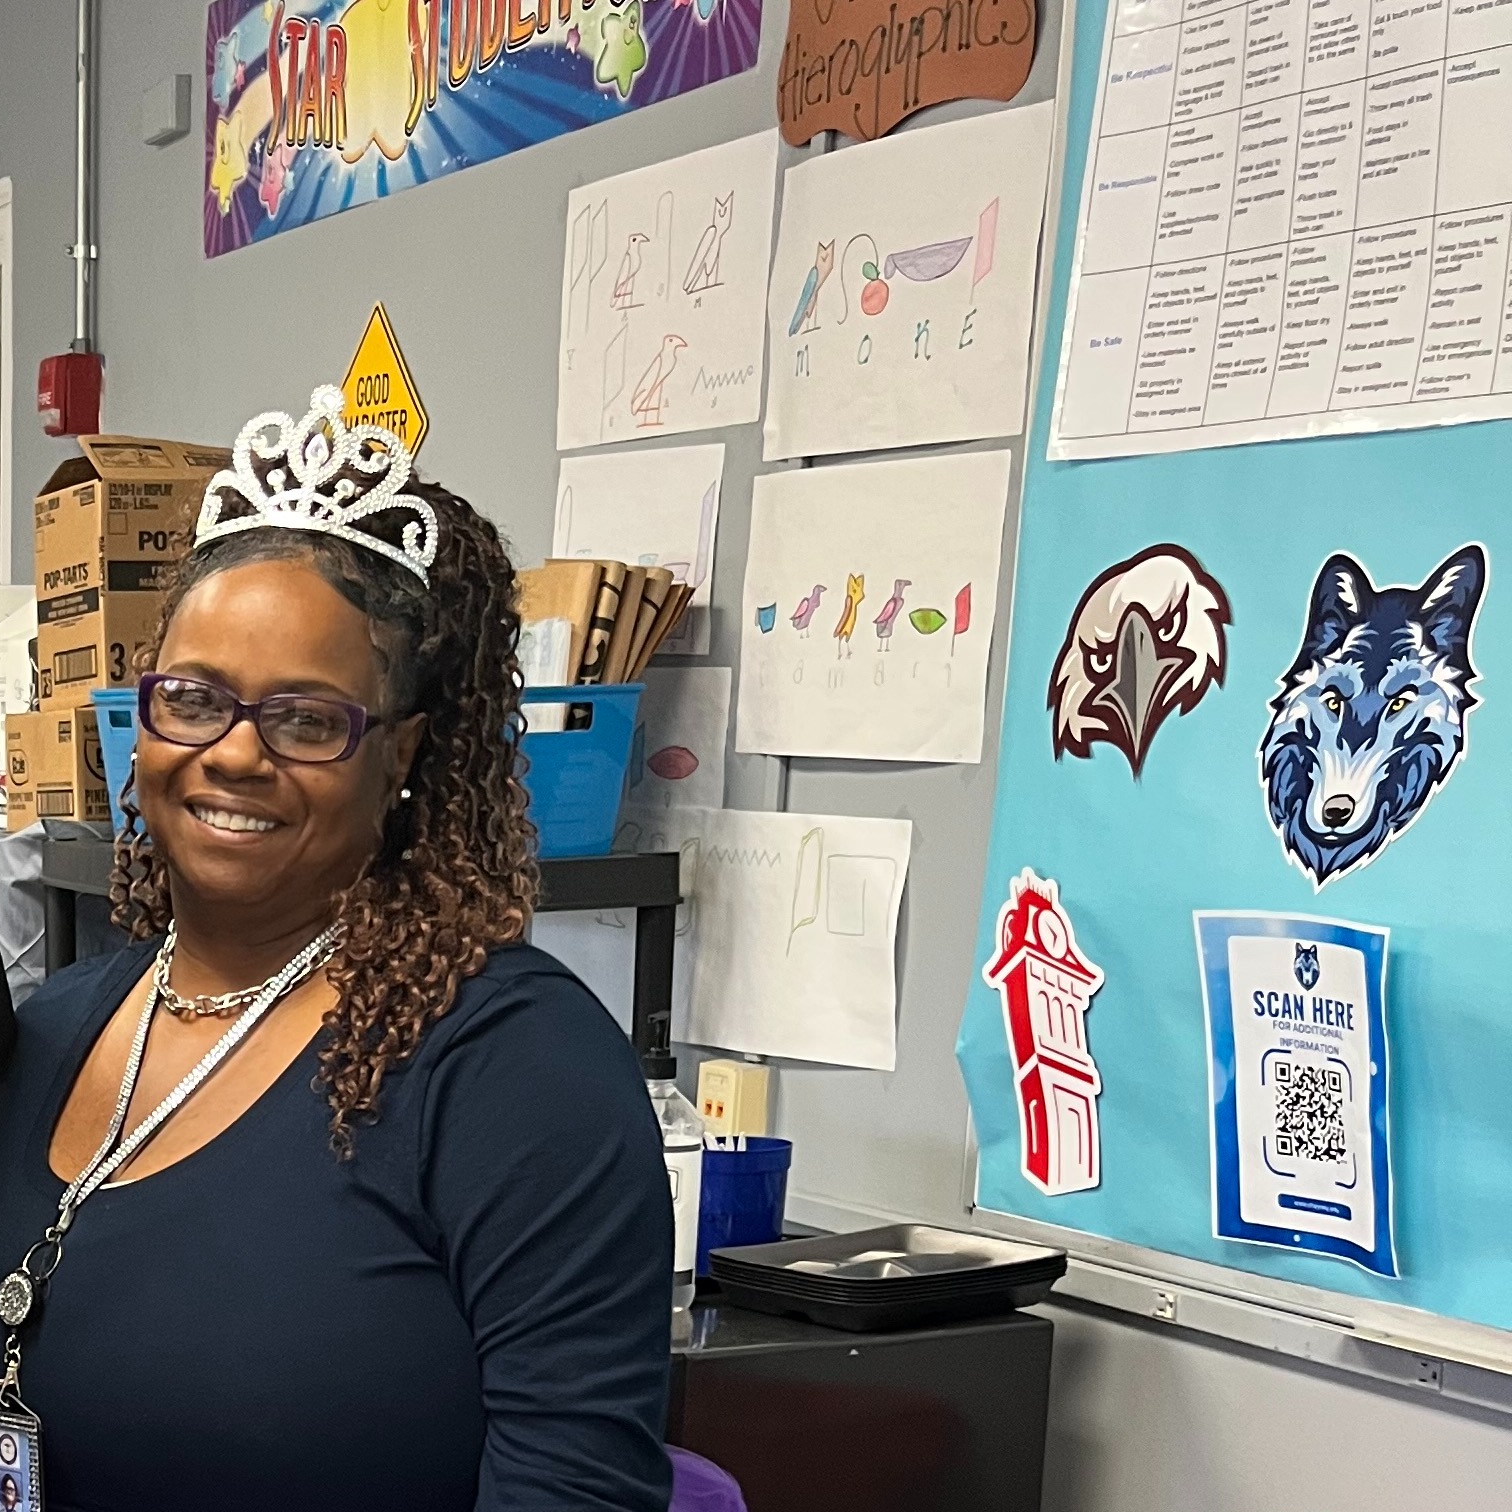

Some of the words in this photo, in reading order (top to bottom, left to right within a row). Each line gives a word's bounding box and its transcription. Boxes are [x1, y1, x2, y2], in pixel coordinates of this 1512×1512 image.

[267, 0, 348, 155] STAR
[356, 373, 390, 408] GOOD
[138, 530, 180, 551] PO
[43, 562, 90, 591] POP-TARTS
[1252, 989, 1304, 1023] SCAN
[1311, 996, 1355, 1032] HERE
[1272, 1020, 1291, 1032] FOR
[1292, 1022, 1344, 1041] ADDITIONAL
[1279, 1036, 1340, 1055] INFORMATION
